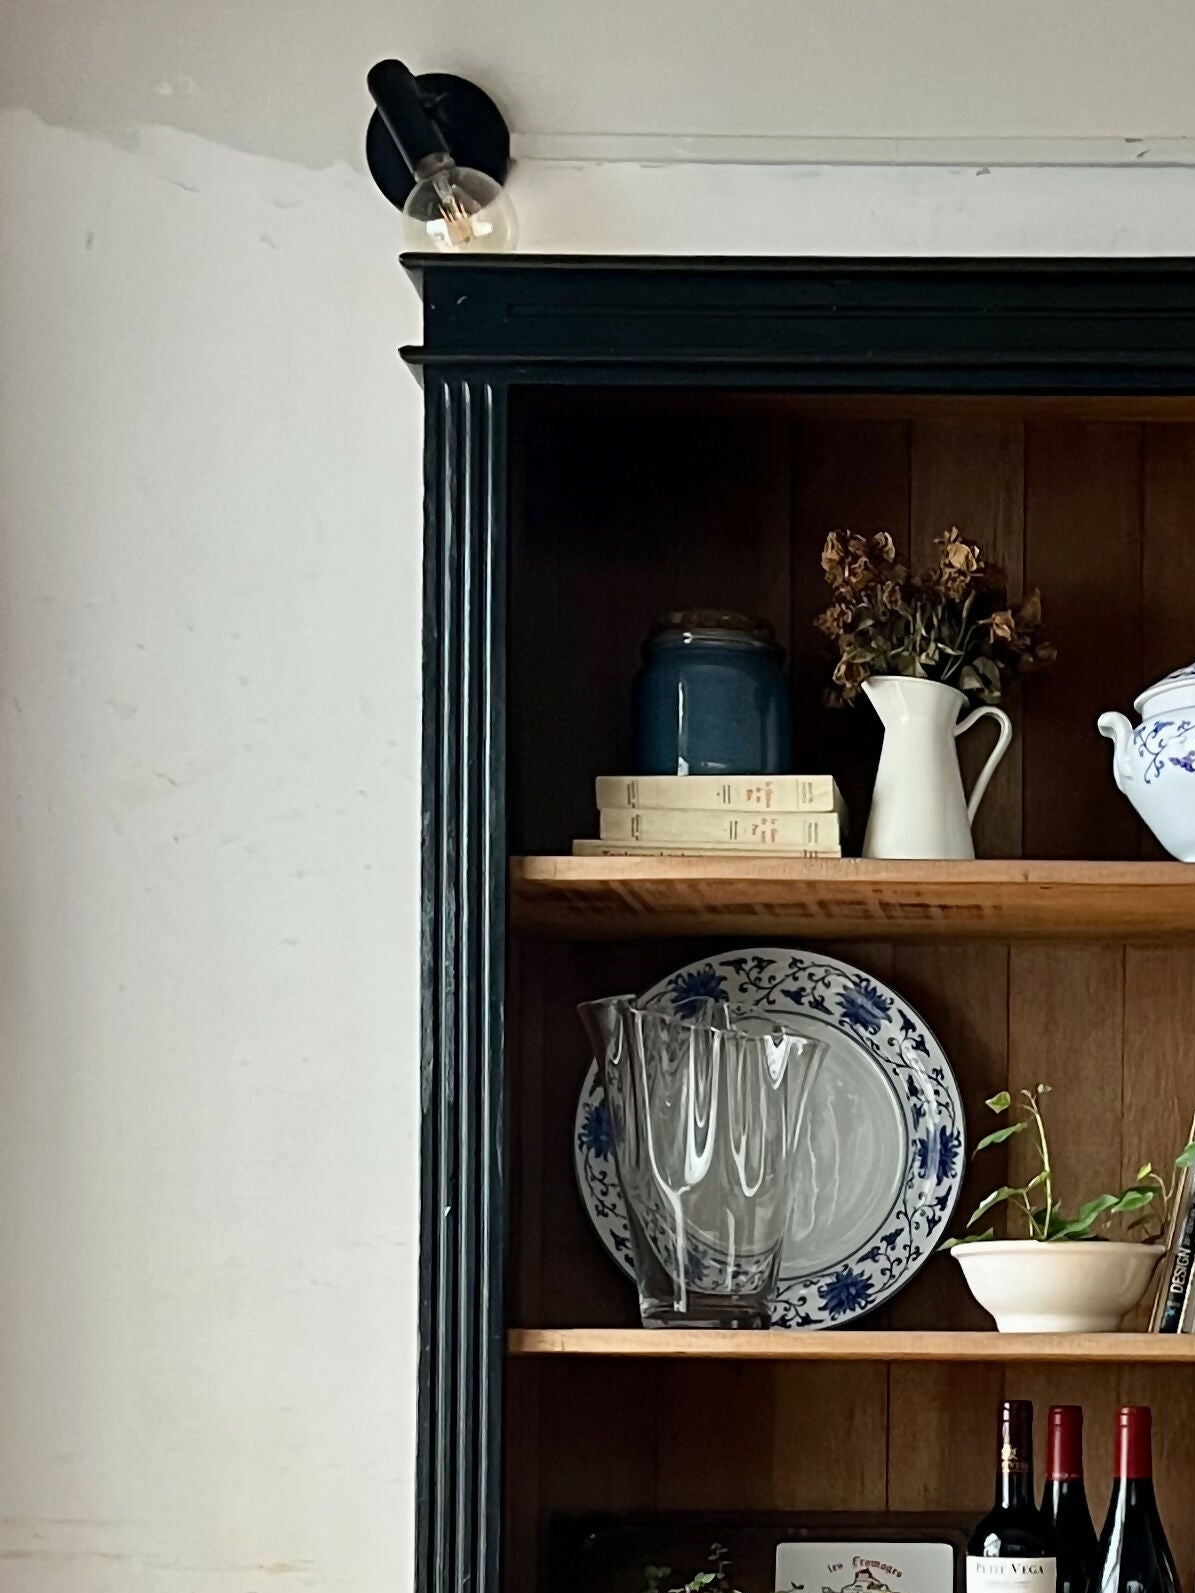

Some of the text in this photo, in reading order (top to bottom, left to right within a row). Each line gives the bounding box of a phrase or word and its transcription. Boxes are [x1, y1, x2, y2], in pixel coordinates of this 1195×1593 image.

[1171, 1247, 1192, 1293] DESIGN
[852, 1555, 903, 1578] Fromages
[1011, 1562, 1045, 1575] VEGA
